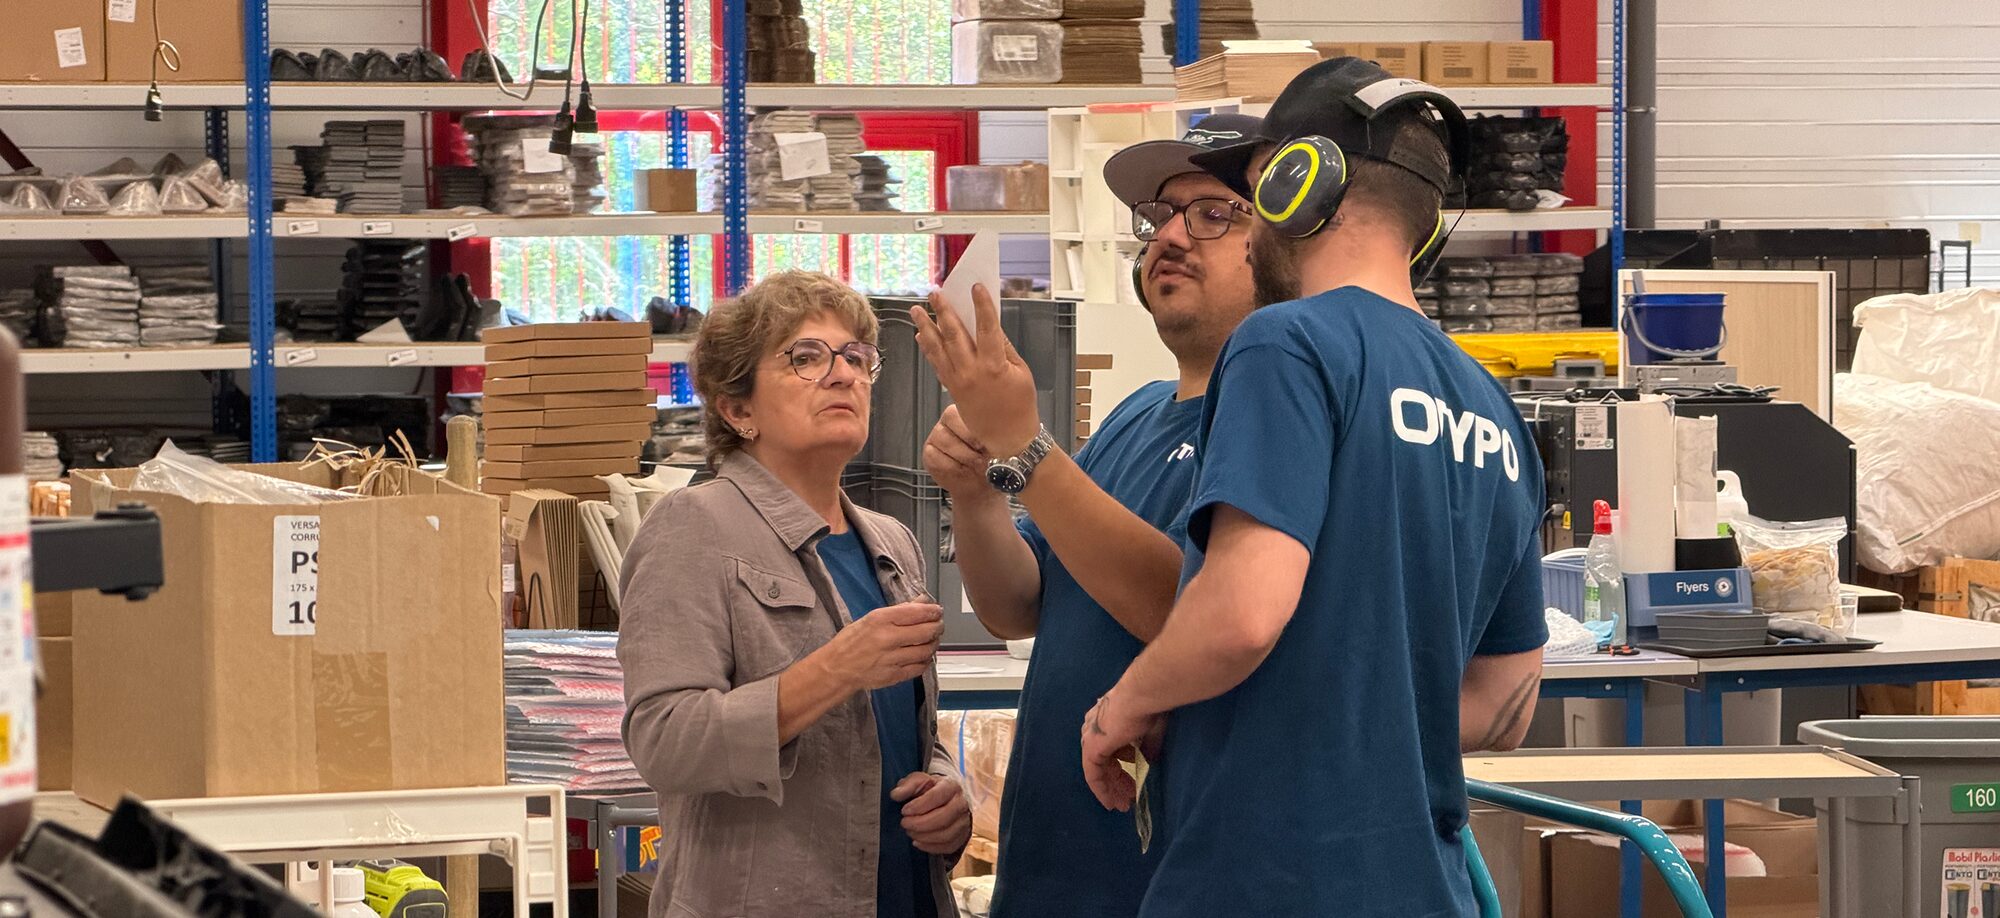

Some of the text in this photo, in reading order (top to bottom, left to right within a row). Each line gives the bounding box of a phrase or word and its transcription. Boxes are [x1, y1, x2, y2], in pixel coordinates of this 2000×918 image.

[290, 584, 307, 592] 175
[1676, 582, 1709, 595] Flyers
[1966, 788, 1996, 807] 160
